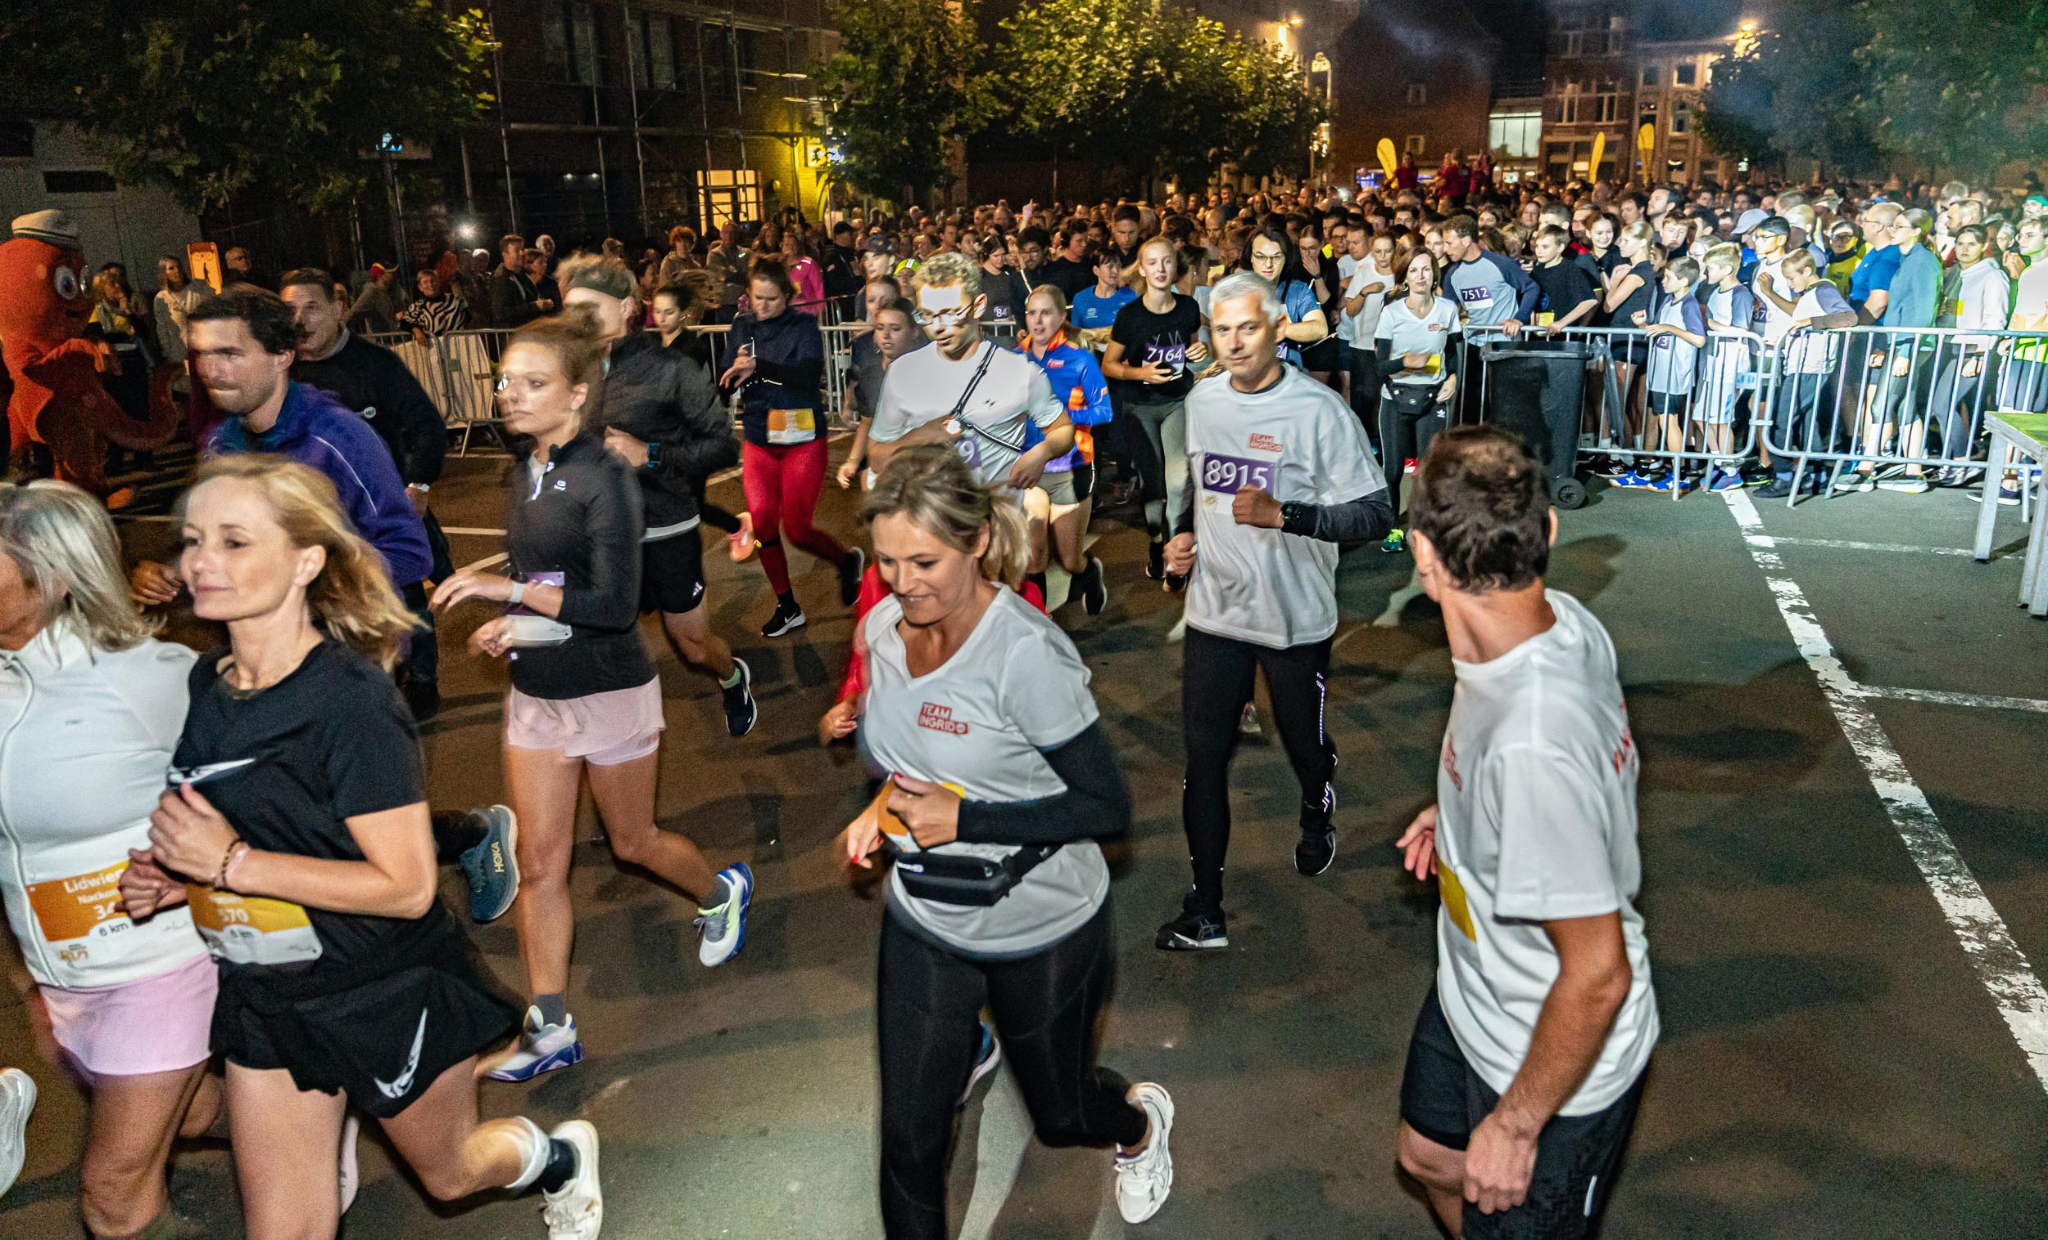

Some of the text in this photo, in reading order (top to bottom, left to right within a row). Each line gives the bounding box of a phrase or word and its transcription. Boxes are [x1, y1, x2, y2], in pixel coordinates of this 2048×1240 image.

[1462, 287, 1489, 300] 7512
[1147, 347, 1183, 362] 7164
[1204, 459, 1269, 491] 8915
[923, 704, 951, 719] TEAM
[919, 715, 955, 732] INGRID
[491, 841, 504, 872] HOKA
[109, 922, 129, 934] km
